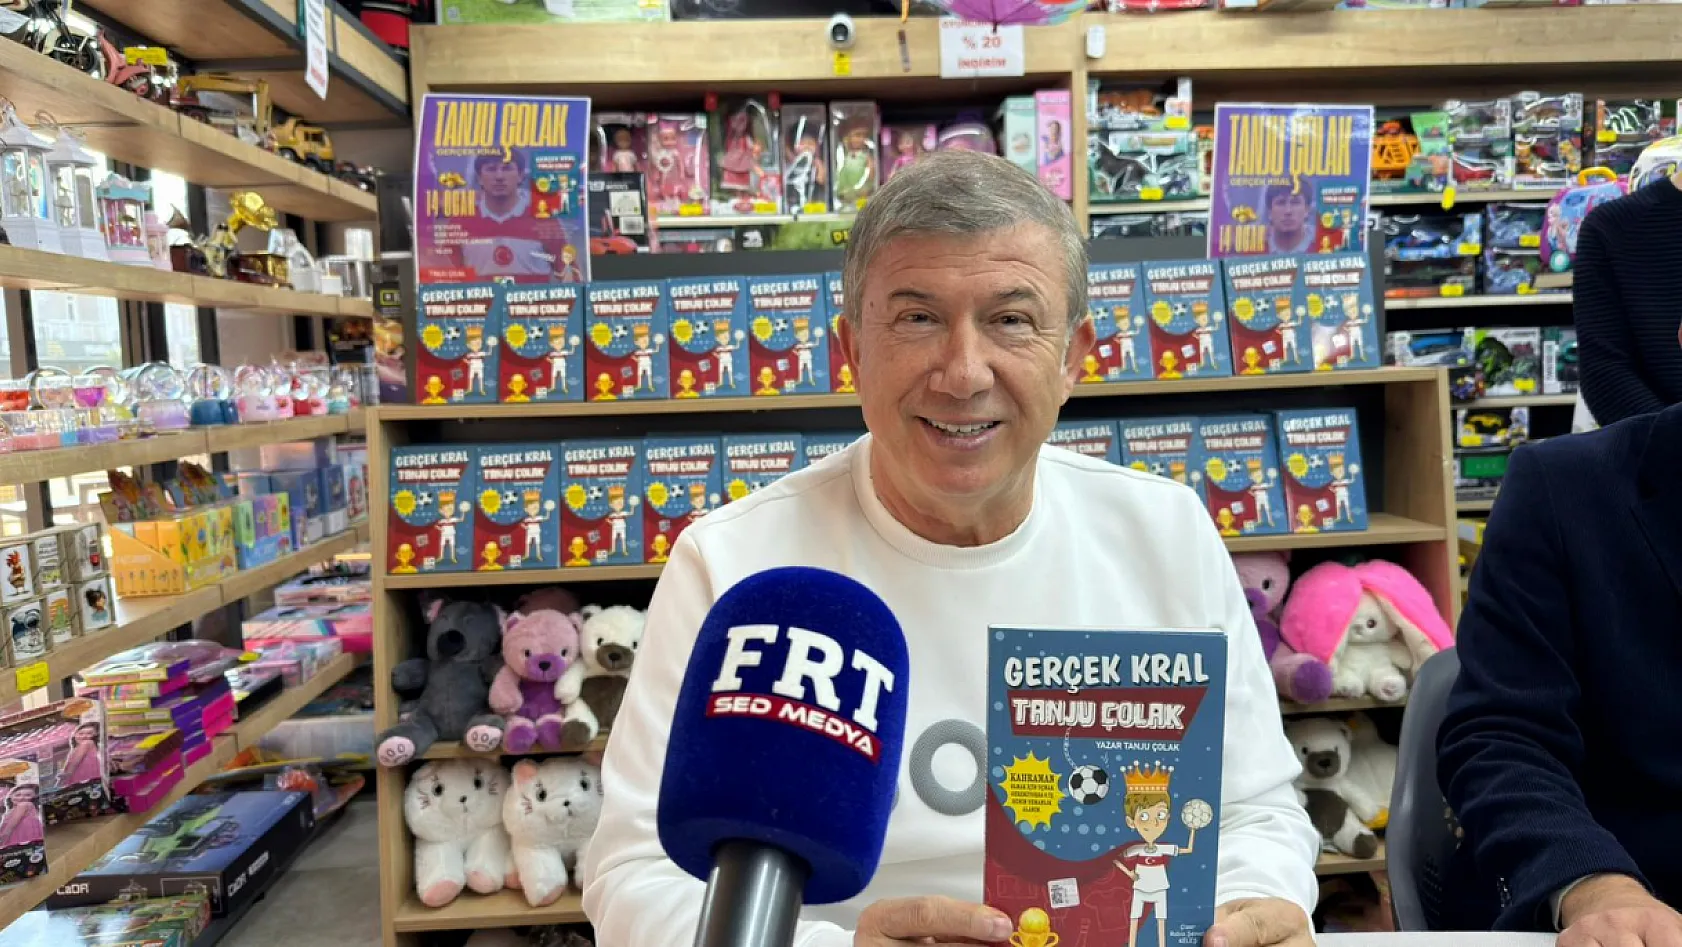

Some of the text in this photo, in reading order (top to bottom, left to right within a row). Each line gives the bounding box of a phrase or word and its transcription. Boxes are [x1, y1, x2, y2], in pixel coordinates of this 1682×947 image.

[983, 36, 1002, 48] 20
[434, 101, 569, 163] TANJU ÇOLAK
[1228, 114, 1353, 195] TANJU ÇOLAK
[426, 189, 476, 217] 14 OCAK
[1219, 224, 1268, 253] 14 OCAK
[1188, 264, 1215, 276] KRAL
[1271, 258, 1298, 271] KRAL
[713, 280, 740, 293] KRAL
[791, 279, 819, 291] KRAL
[466, 287, 494, 300] KRAL
[550, 287, 577, 299] KRAL
[633, 286, 660, 298] KRAL
[1240, 420, 1267, 433] KRAL
[1324, 414, 1351, 427] KRAL
[1167, 422, 1193, 435] KRAL
[608, 446, 636, 457] KRAL
[690, 444, 717, 455] KRAL
[769, 441, 797, 452] KRAL
[441, 451, 470, 463] KRAL
[524, 450, 553, 462] KRAL
[711, 624, 895, 733] FRT
[1004, 652, 1210, 695] GERÇEK KRAL
[1011, 697, 1186, 731] TANJU ÇOLAK
[713, 697, 873, 756] SED MEDYA
[1095, 741, 1180, 752] YAZAR TANJU ÇOLAK
[1010, 772, 1054, 783] KAHRAMAN
